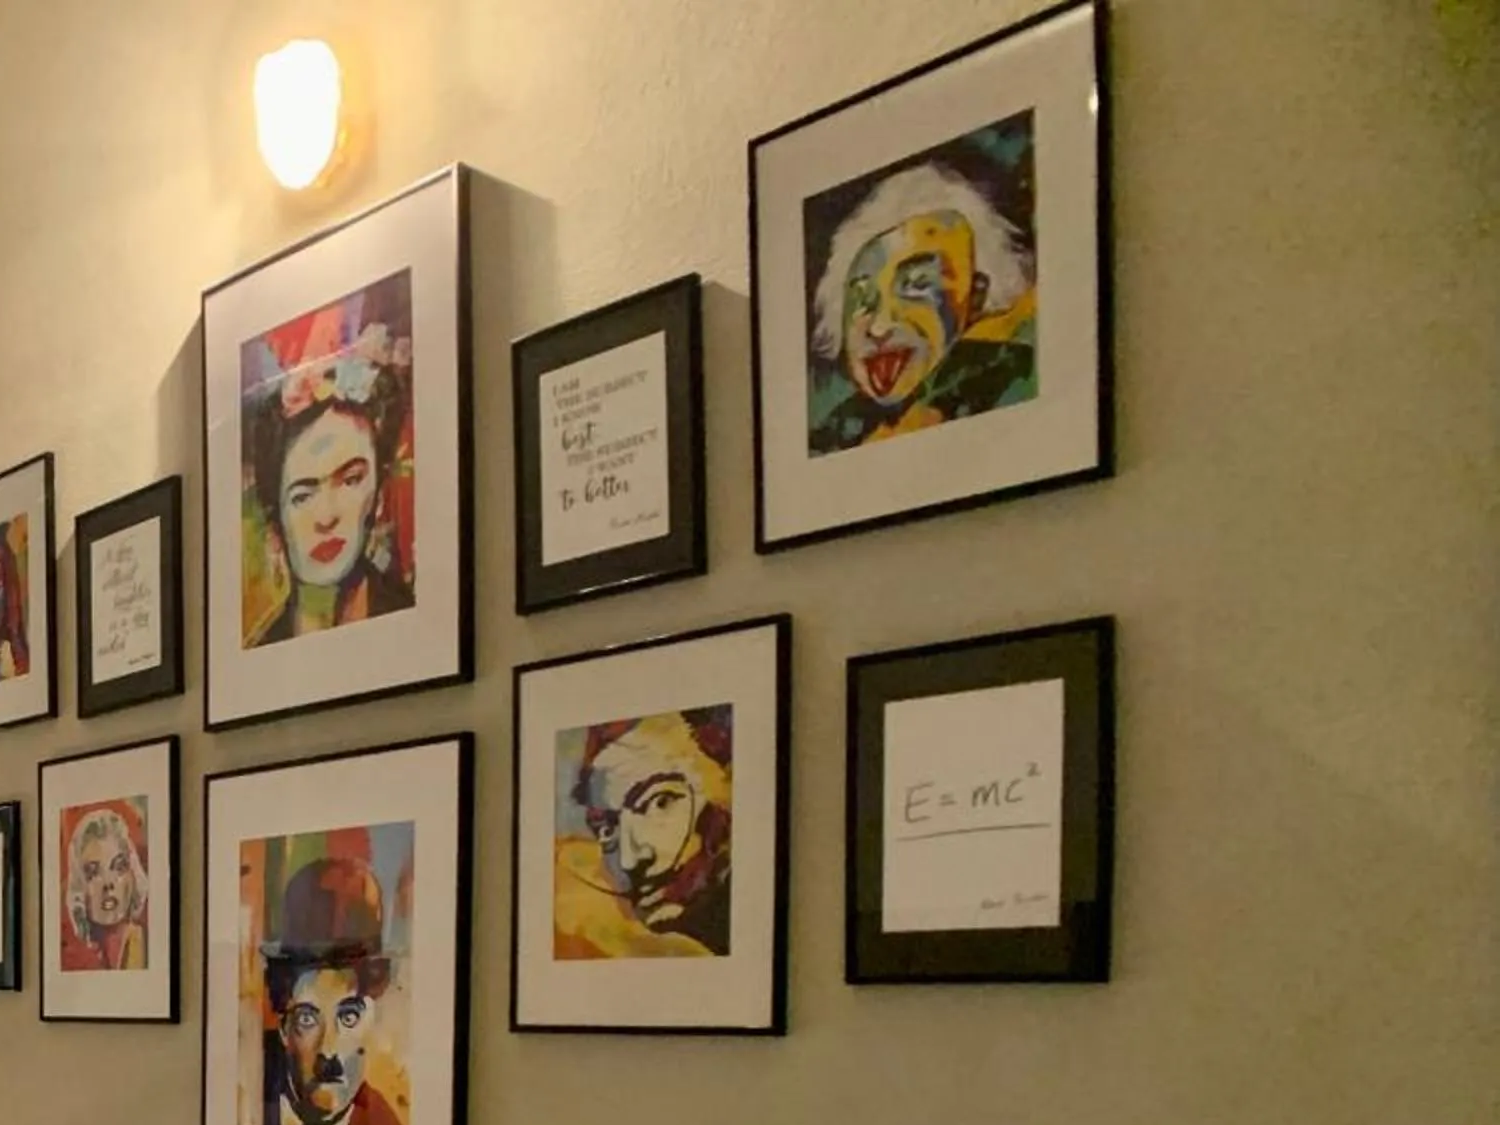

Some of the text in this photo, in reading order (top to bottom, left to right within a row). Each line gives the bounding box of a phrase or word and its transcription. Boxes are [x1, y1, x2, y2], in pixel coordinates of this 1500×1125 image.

[561, 421, 596, 451] best
[558, 475, 629, 512] to better
[904, 781, 934, 823] E
